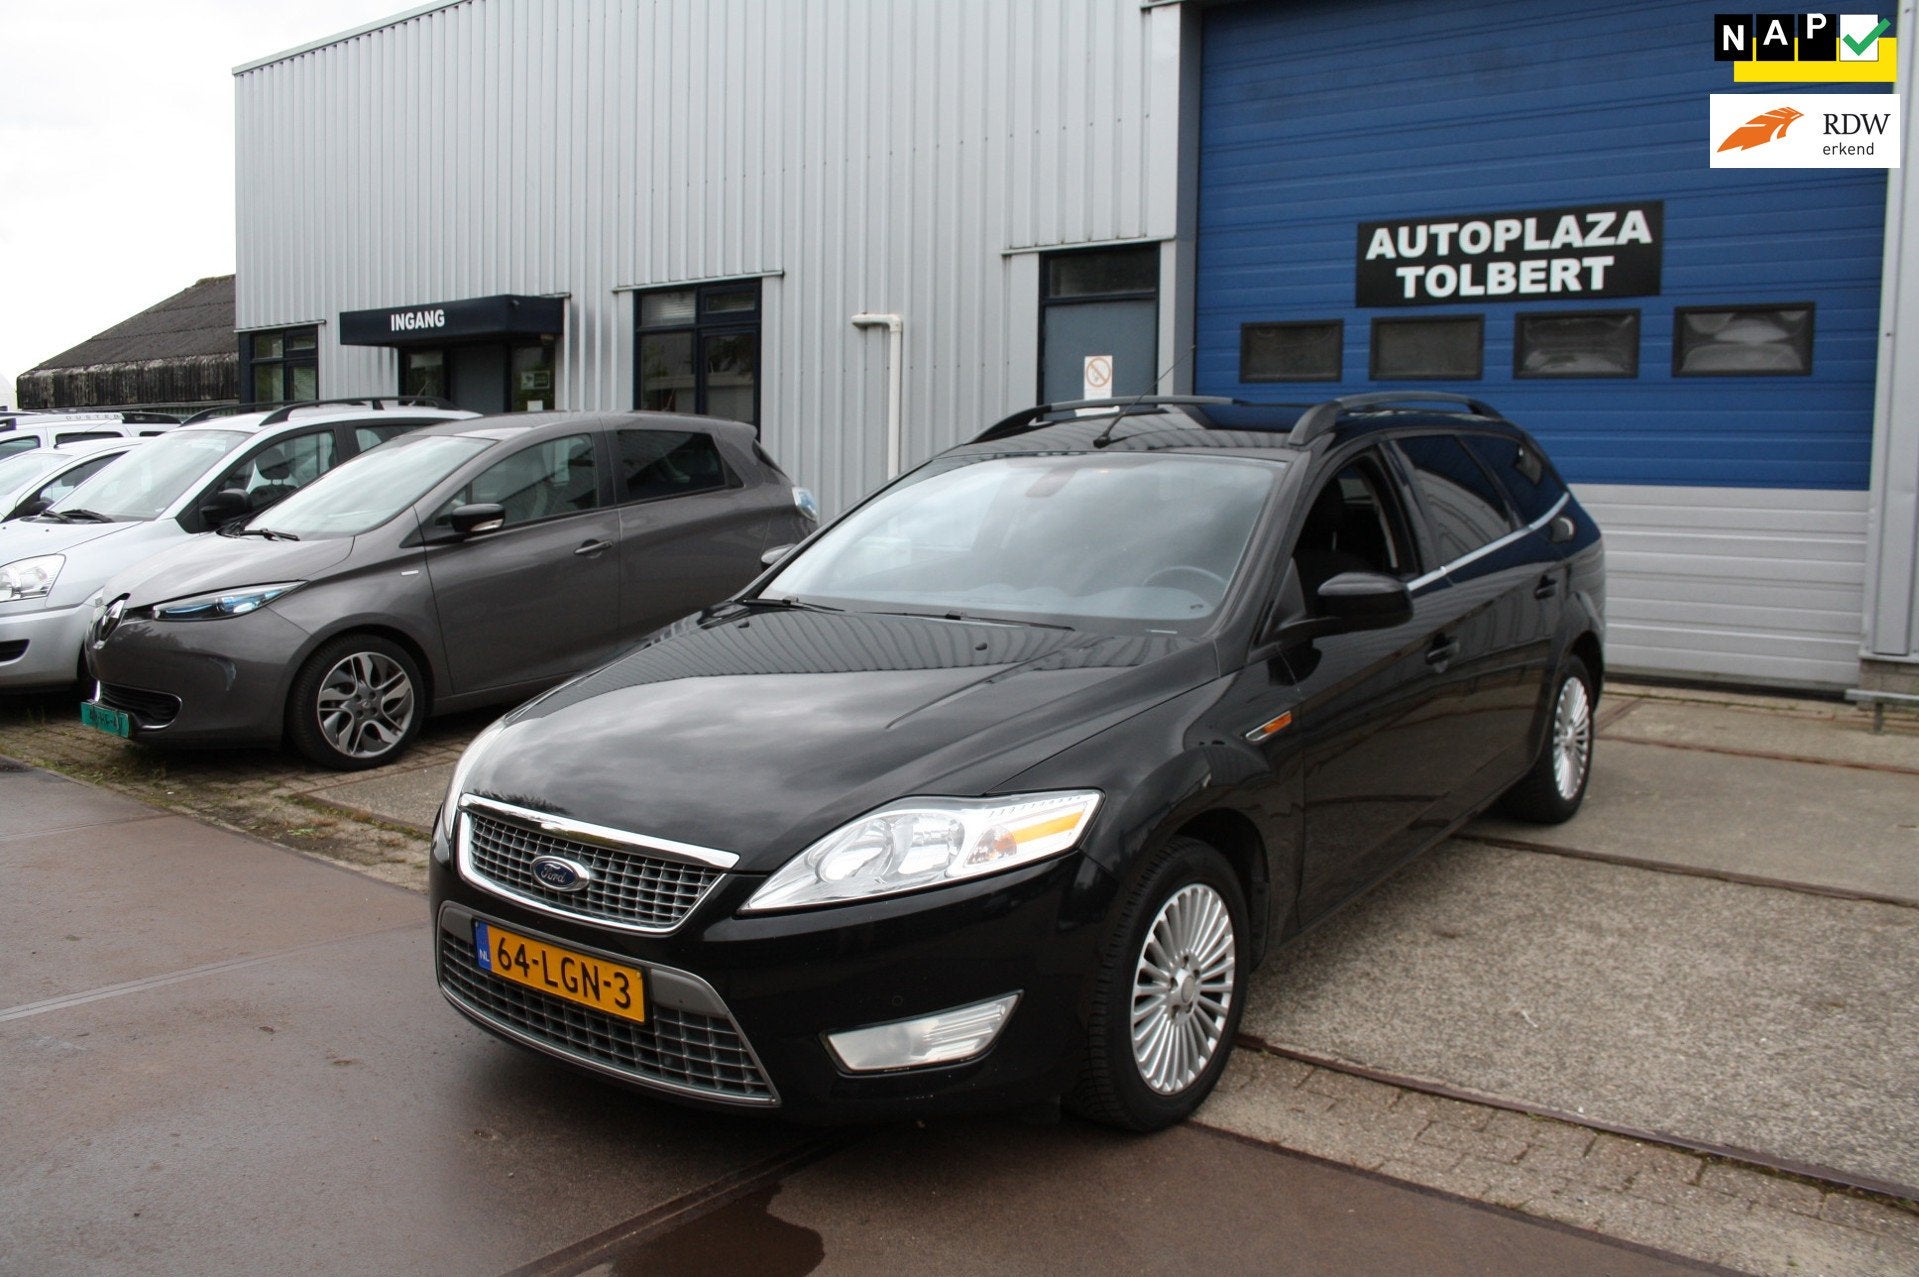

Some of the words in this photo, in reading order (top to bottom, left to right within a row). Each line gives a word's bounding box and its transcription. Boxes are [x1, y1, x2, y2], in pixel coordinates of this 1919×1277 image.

[1365, 210, 1652, 260] AUTOPLAZA
[1396, 255, 1614, 298] TOLBERT
[391, 309, 445, 331] INGANG
[540, 863, 567, 883] Ford
[479, 948, 490, 962] NL
[497, 937, 631, 1010] 64-LGN-3
